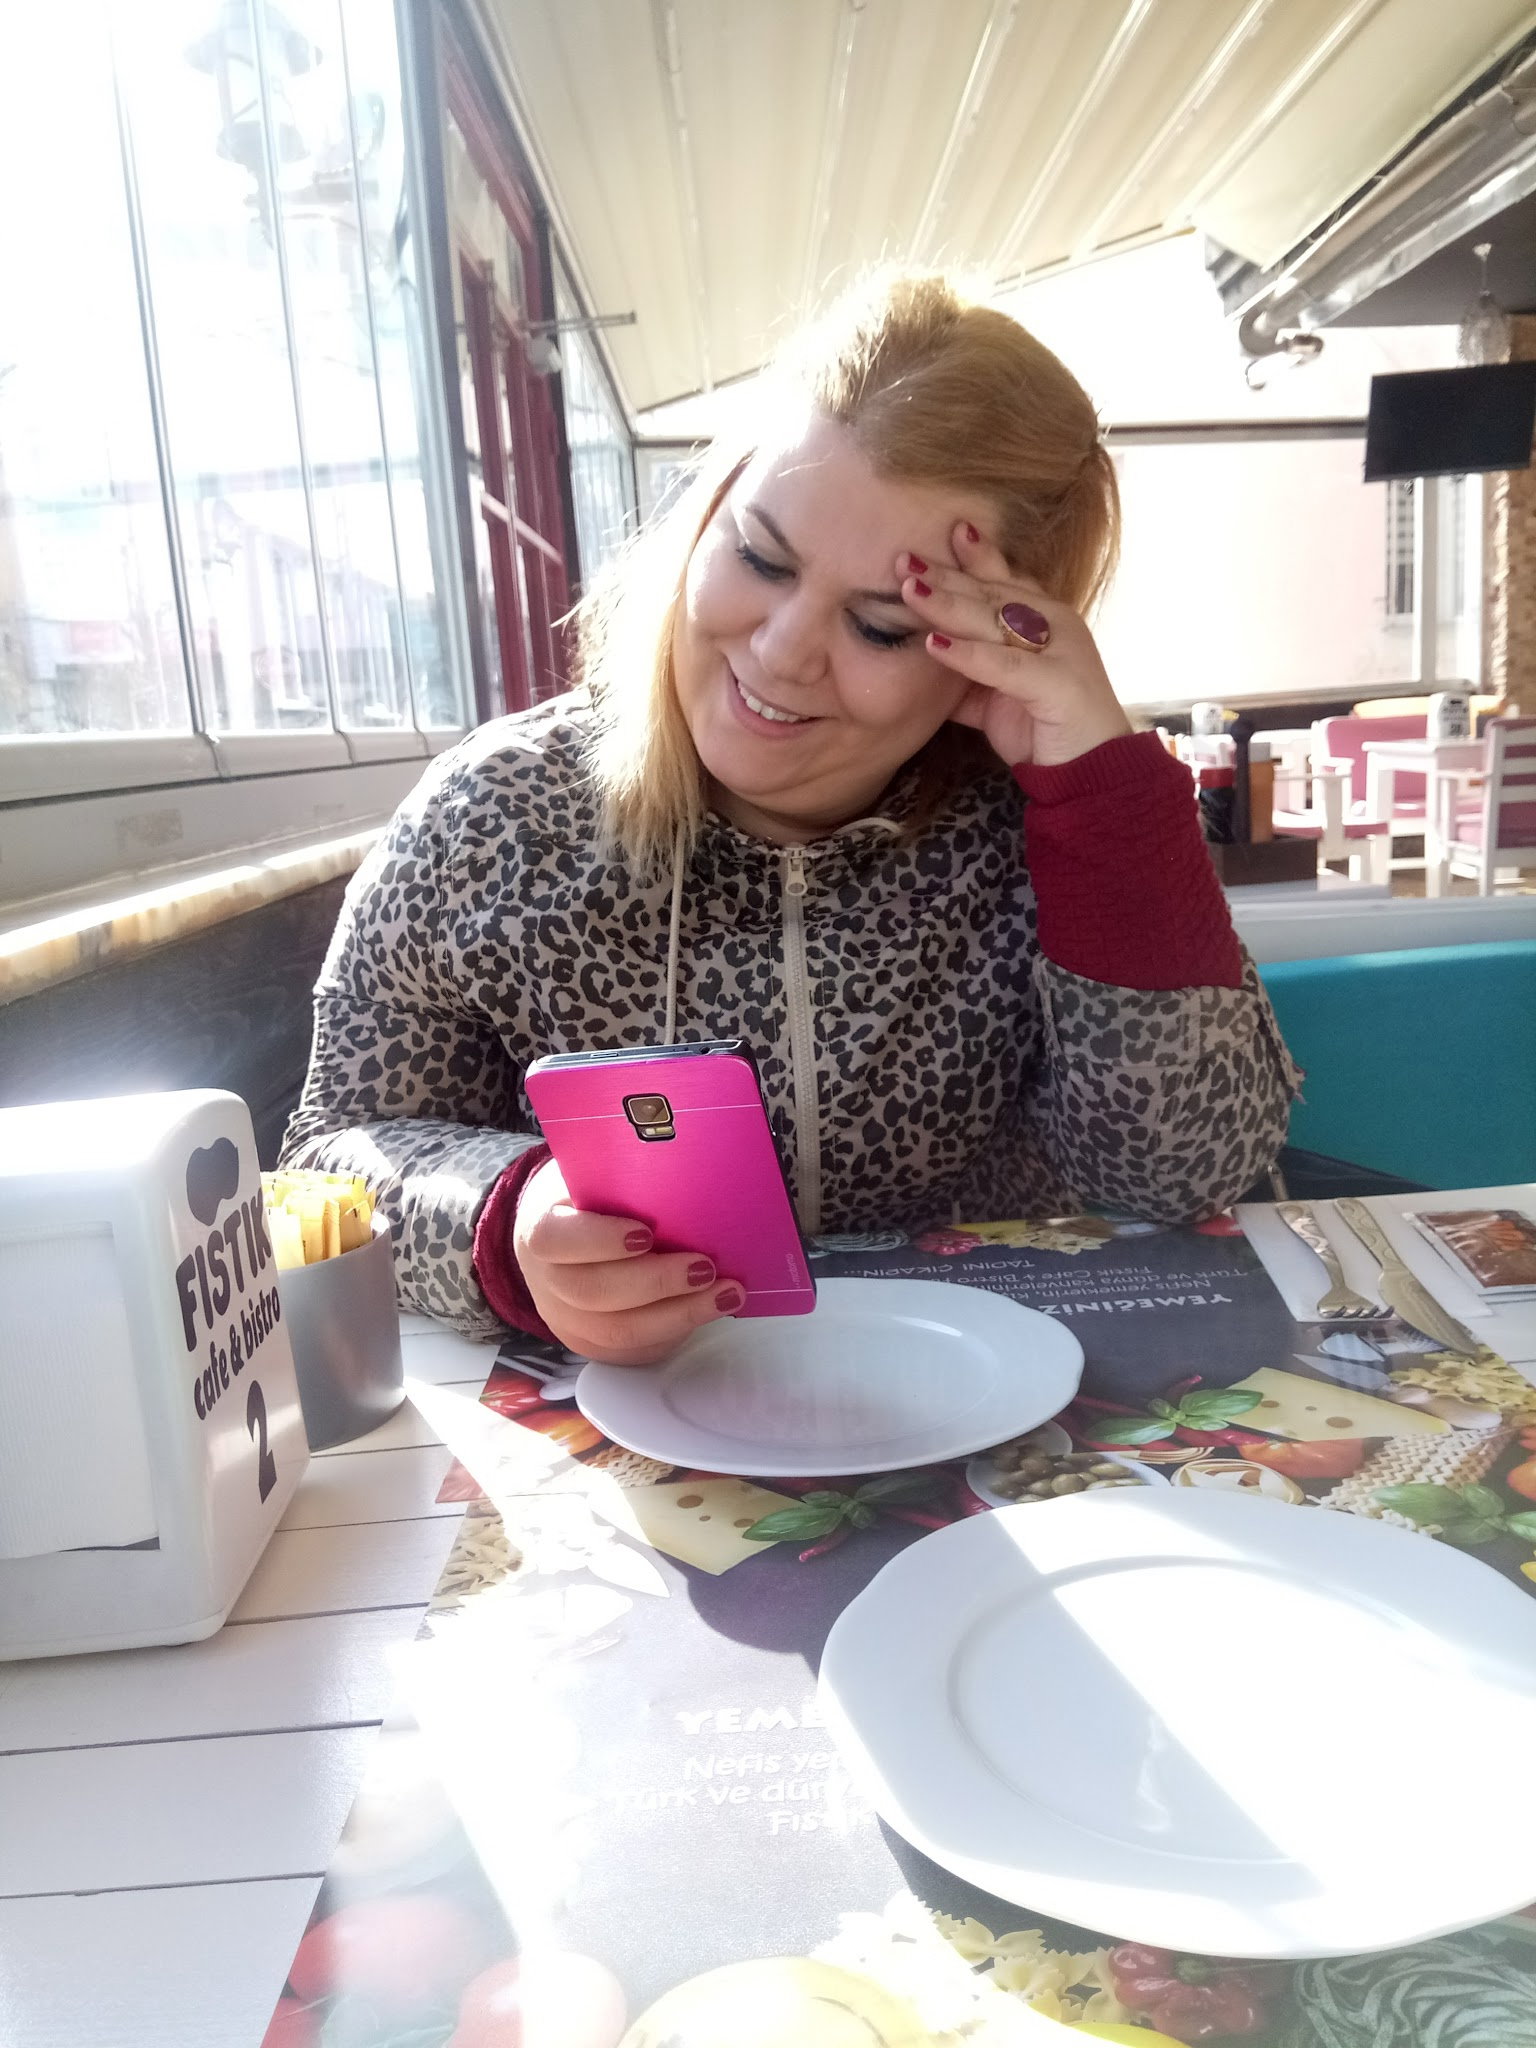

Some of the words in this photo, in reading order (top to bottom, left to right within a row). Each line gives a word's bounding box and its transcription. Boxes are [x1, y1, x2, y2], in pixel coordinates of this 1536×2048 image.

[175, 1186, 272, 1352] FISTIK
[962, 1259, 1036, 1271] TADINI
[1166, 1272, 1191, 1282] ve
[1155, 1279, 1211, 1291] Nefis
[193, 1340, 230, 1421] cafe
[229, 1323, 245, 1377] &
[240, 1285, 281, 1360] bistro
[246, 1379, 277, 1504] 2
[683, 1752, 784, 1781] Nefis
[706, 1783, 752, 1806] ve
